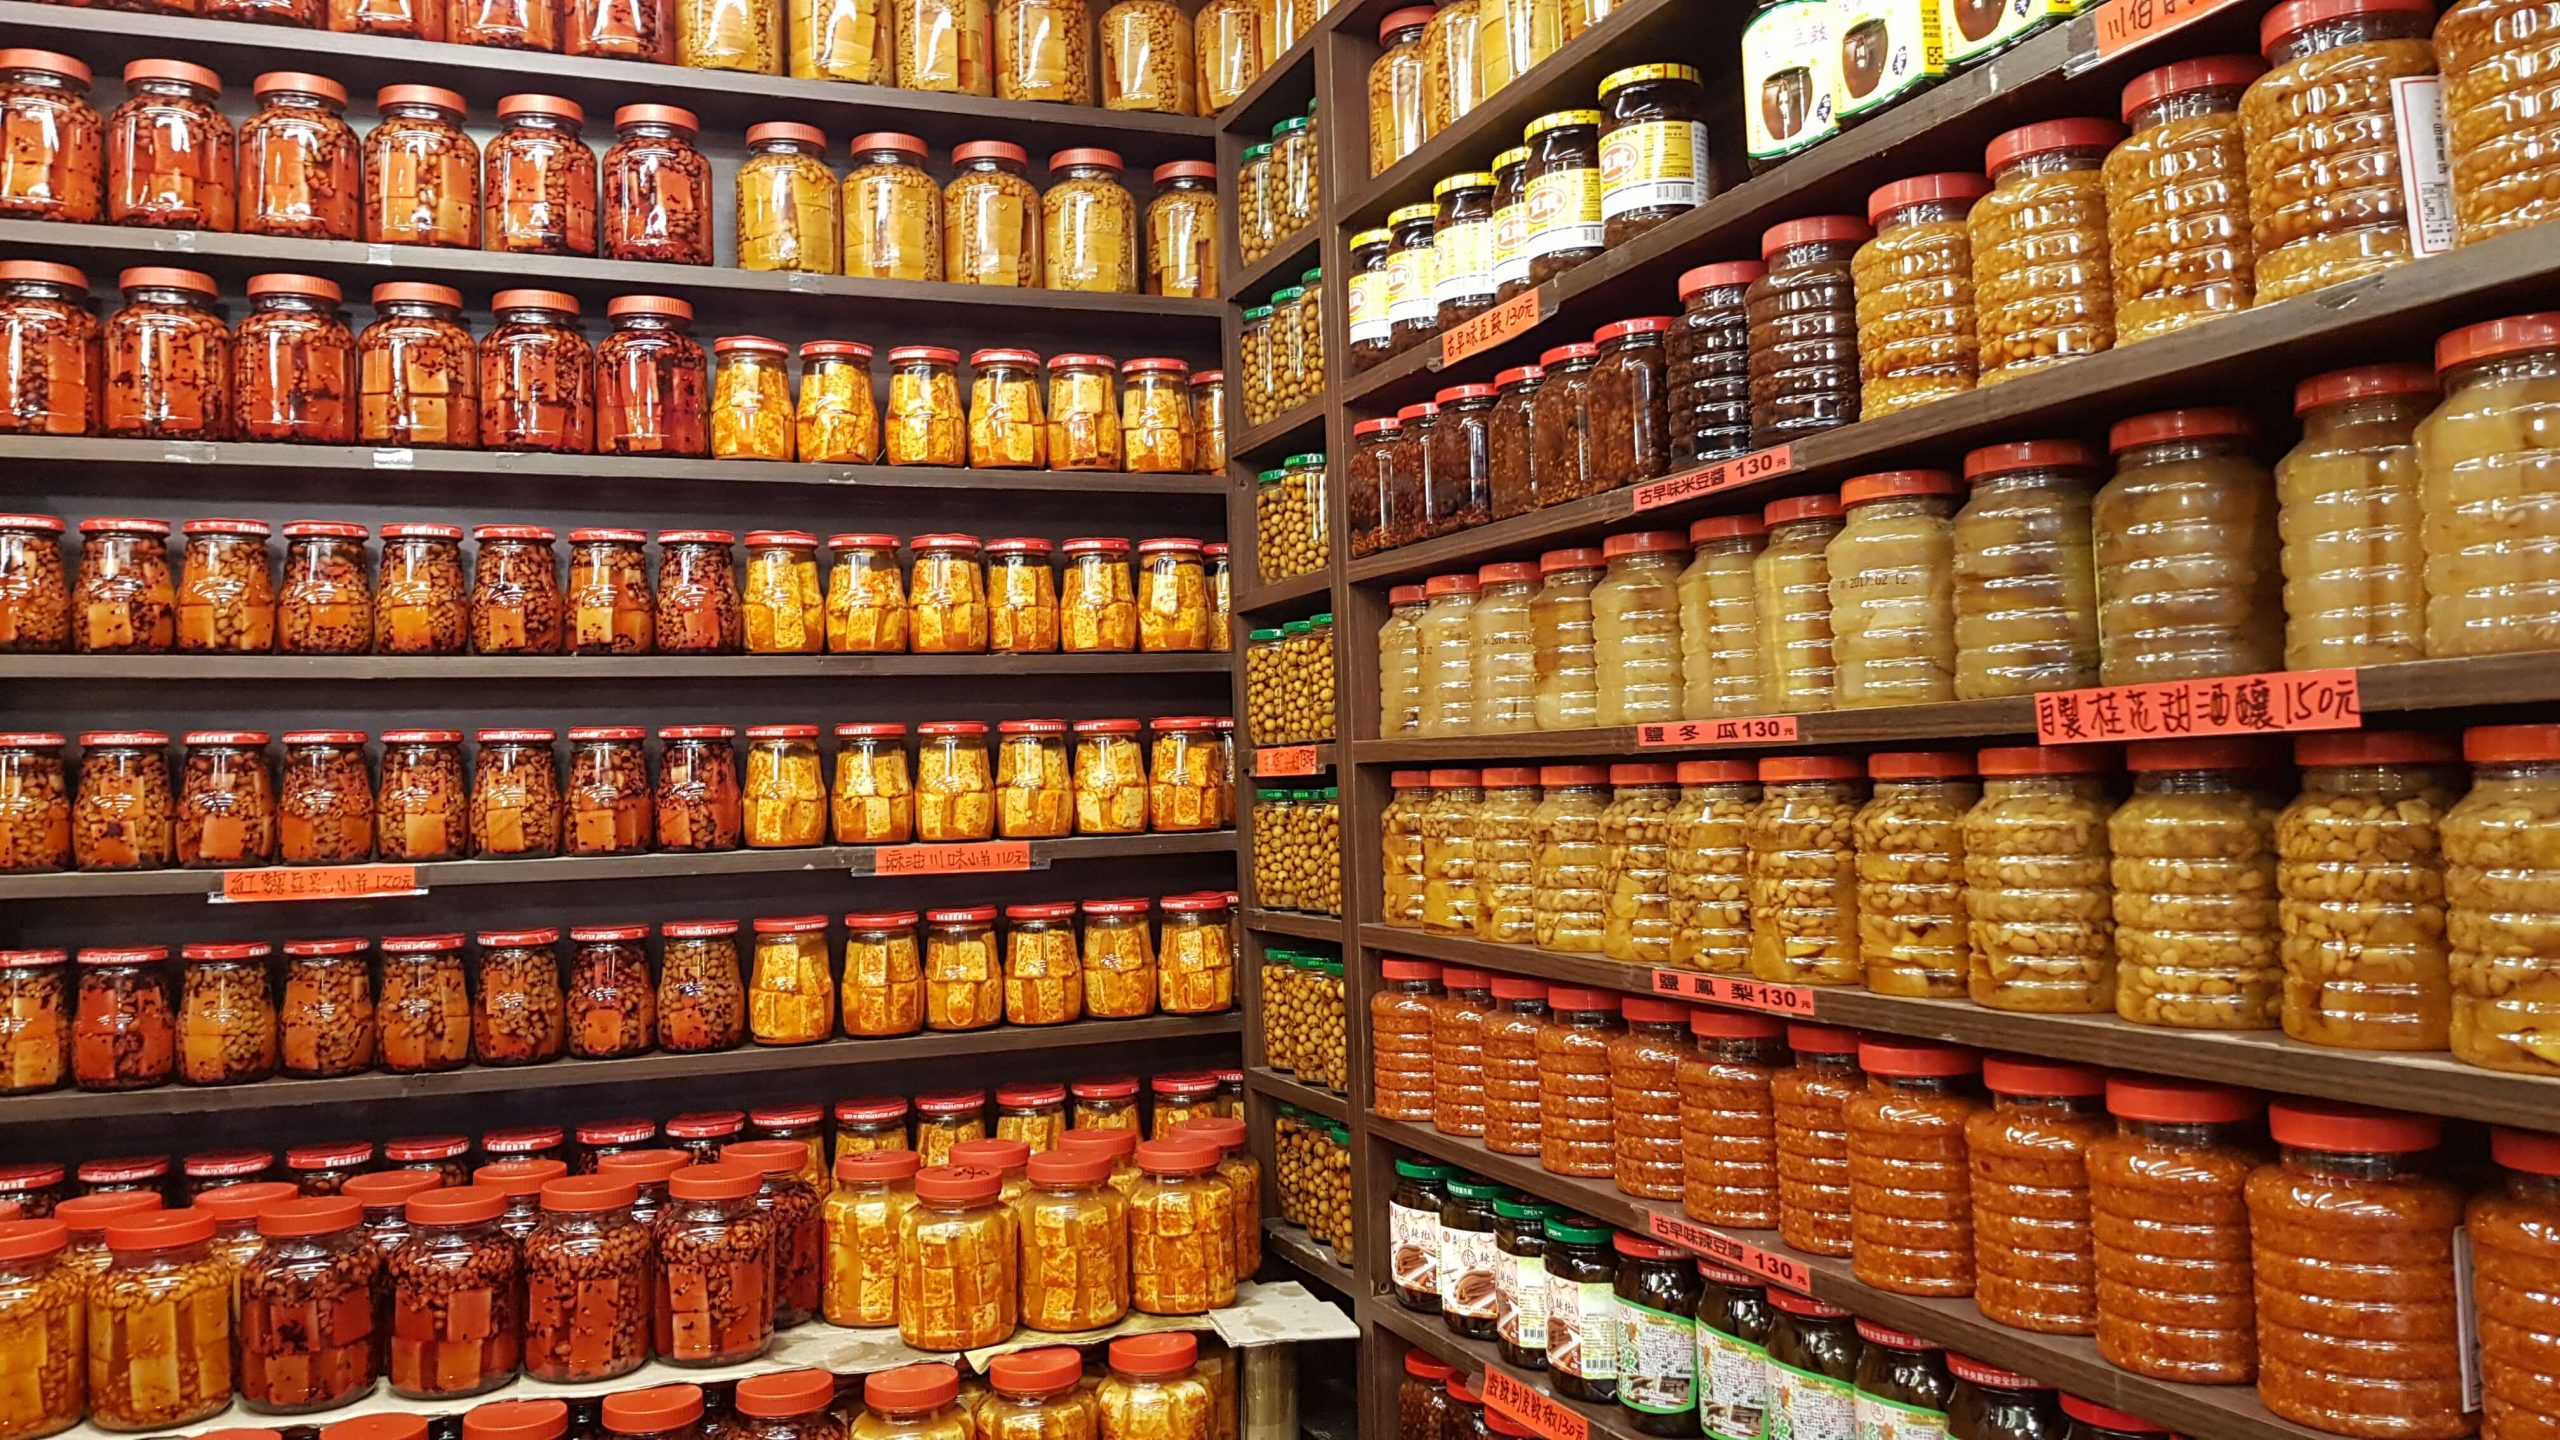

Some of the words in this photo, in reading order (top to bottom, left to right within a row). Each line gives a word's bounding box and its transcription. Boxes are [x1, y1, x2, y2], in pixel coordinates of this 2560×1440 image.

[1639, 467, 1726, 506] 古早味米豆醬
